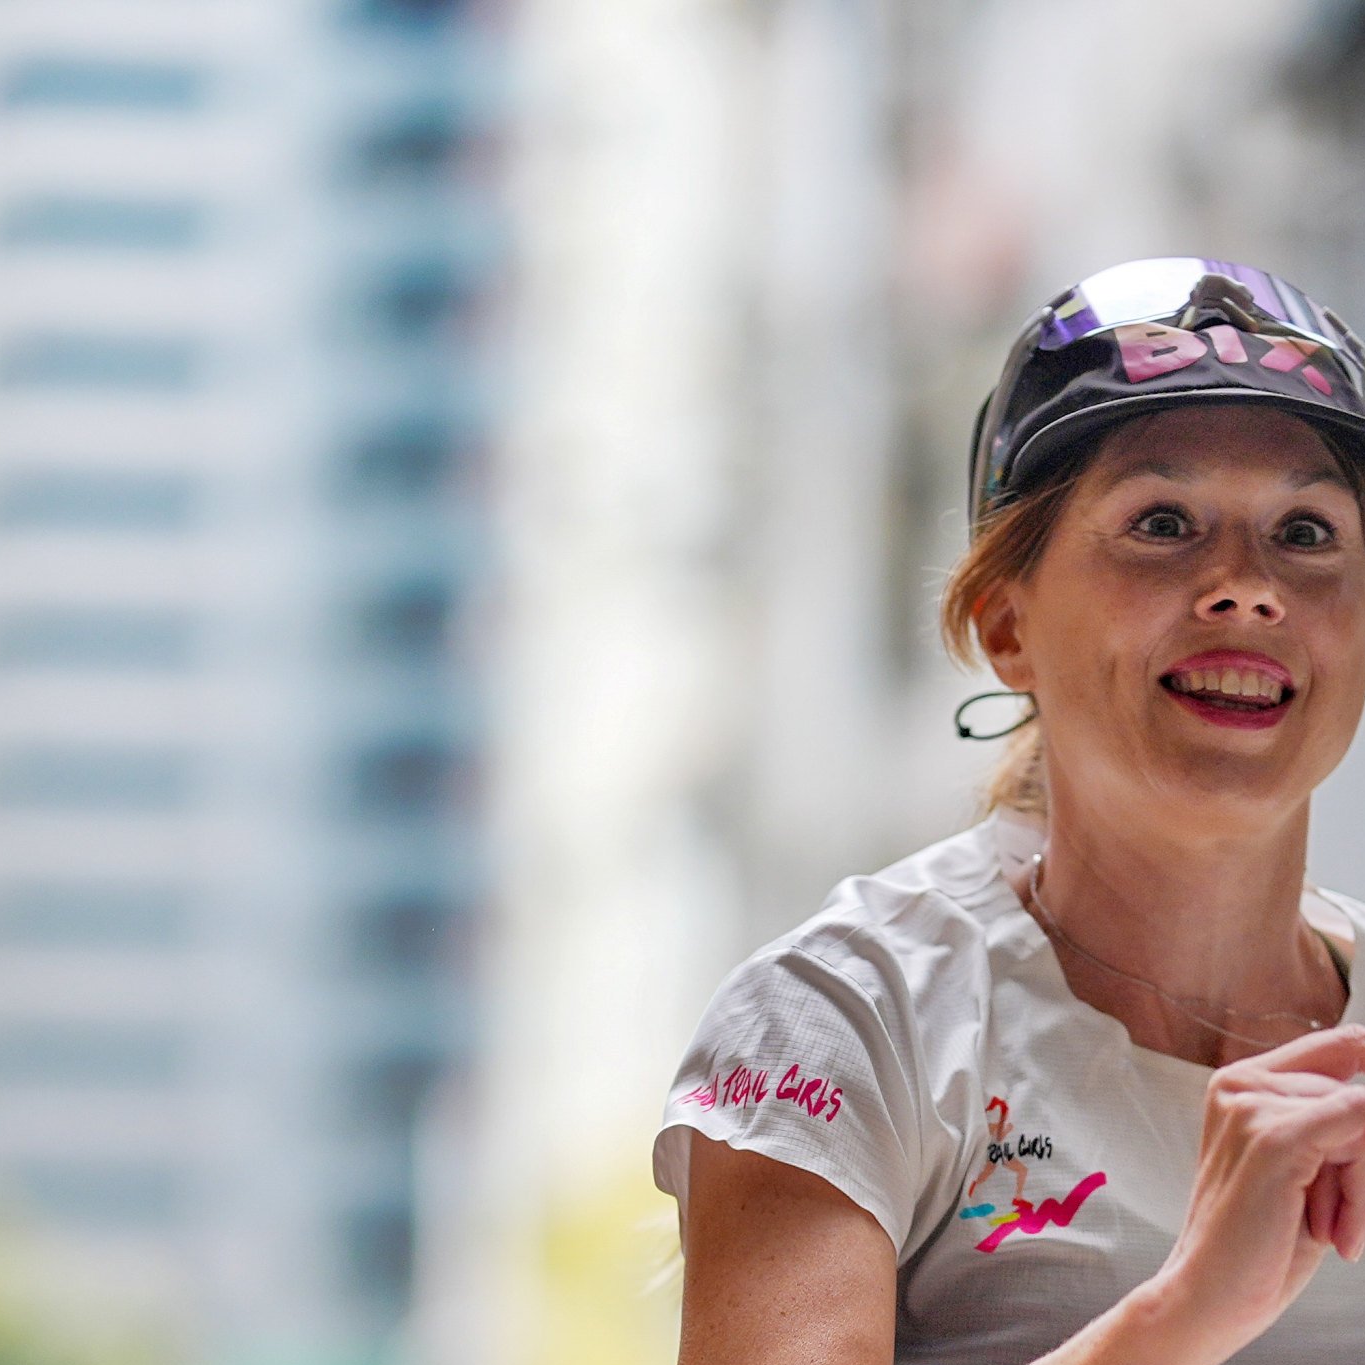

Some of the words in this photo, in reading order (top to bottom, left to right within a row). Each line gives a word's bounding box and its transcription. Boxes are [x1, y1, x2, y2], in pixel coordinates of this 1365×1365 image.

[775, 1063, 843, 1123] GIRLS
[987, 1142, 1015, 1166] RAIL
[1018, 1133, 1053, 1160] GIRLS
